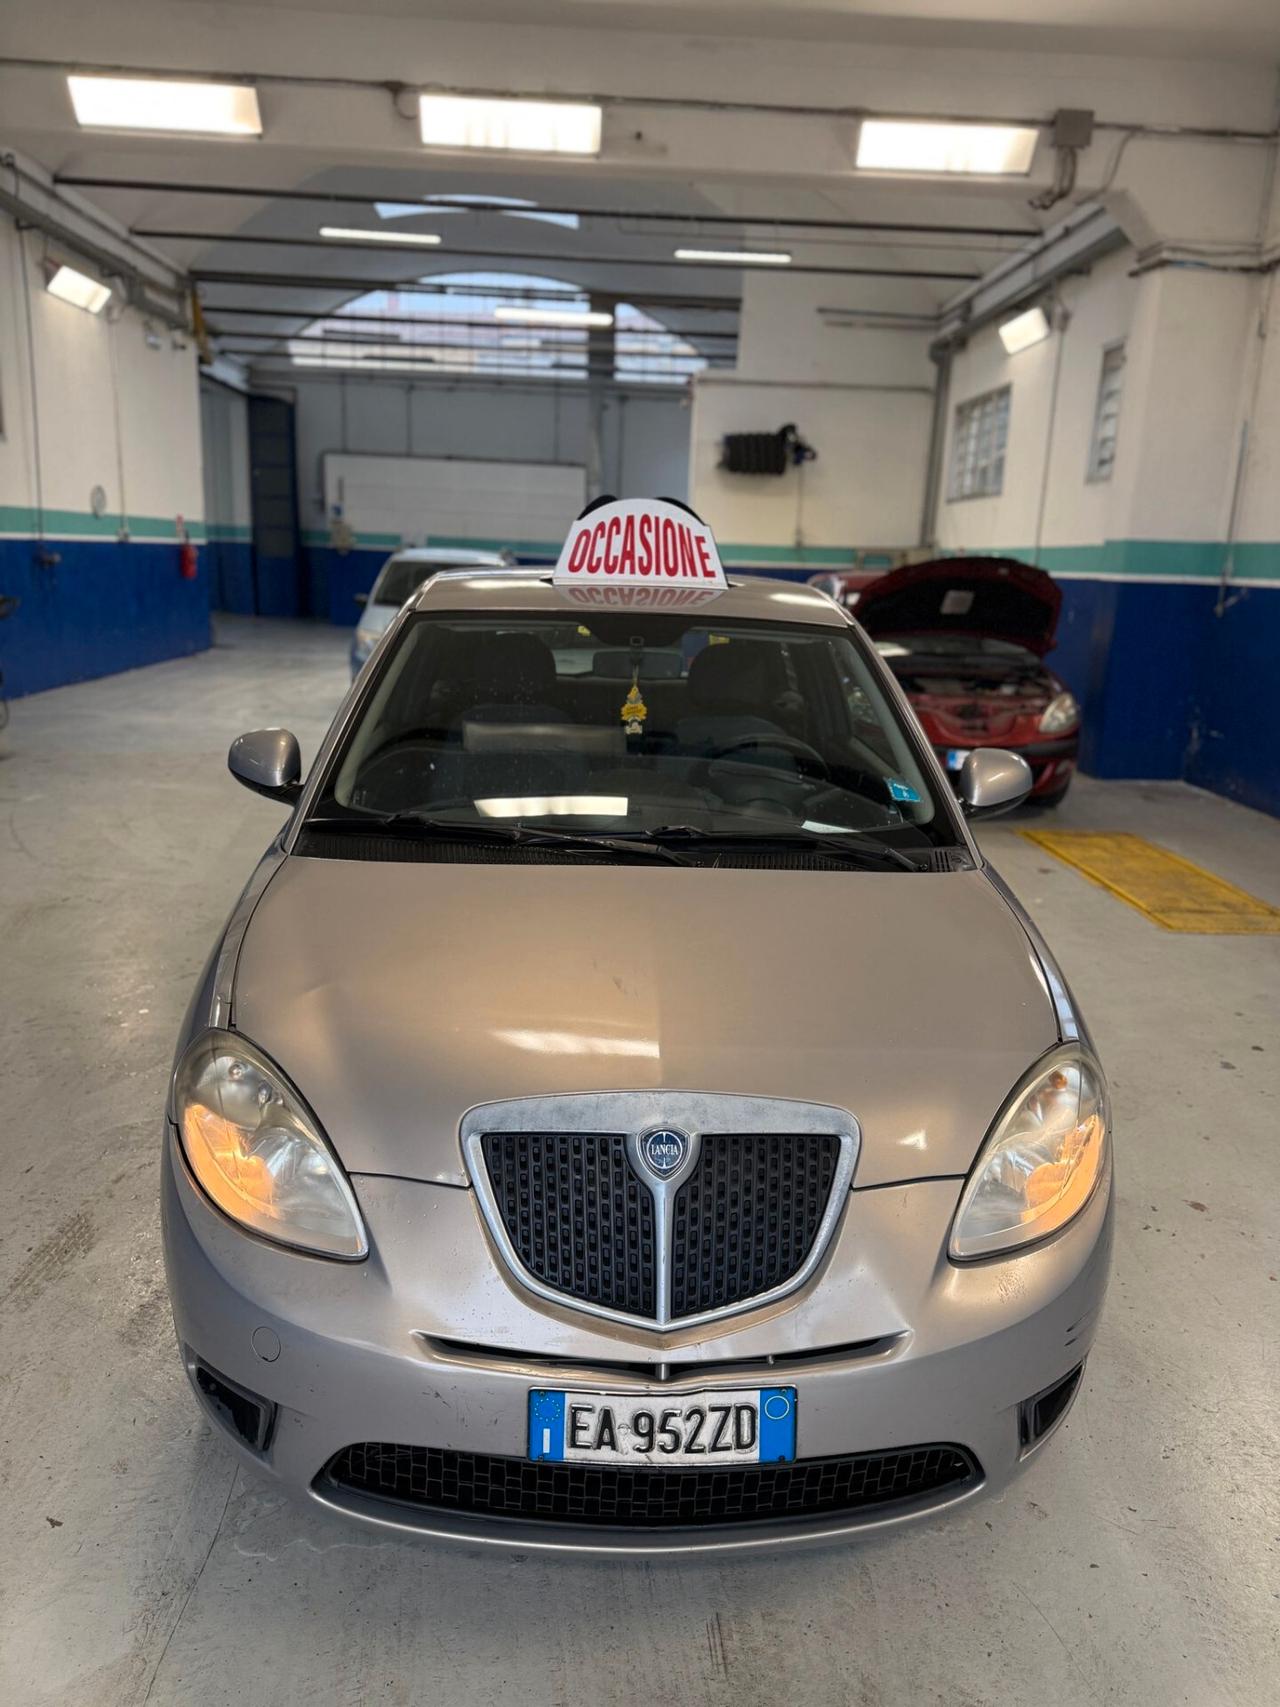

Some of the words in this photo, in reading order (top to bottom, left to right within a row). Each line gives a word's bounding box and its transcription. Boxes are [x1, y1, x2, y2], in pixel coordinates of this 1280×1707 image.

[568, 514, 716, 578] OCCASIONE
[651, 1144, 679, 1156] LANCIA
[542, 1428, 550, 1454] I
[569, 1403, 617, 1450] EA
[631, 1403, 757, 1454] 952ZD
